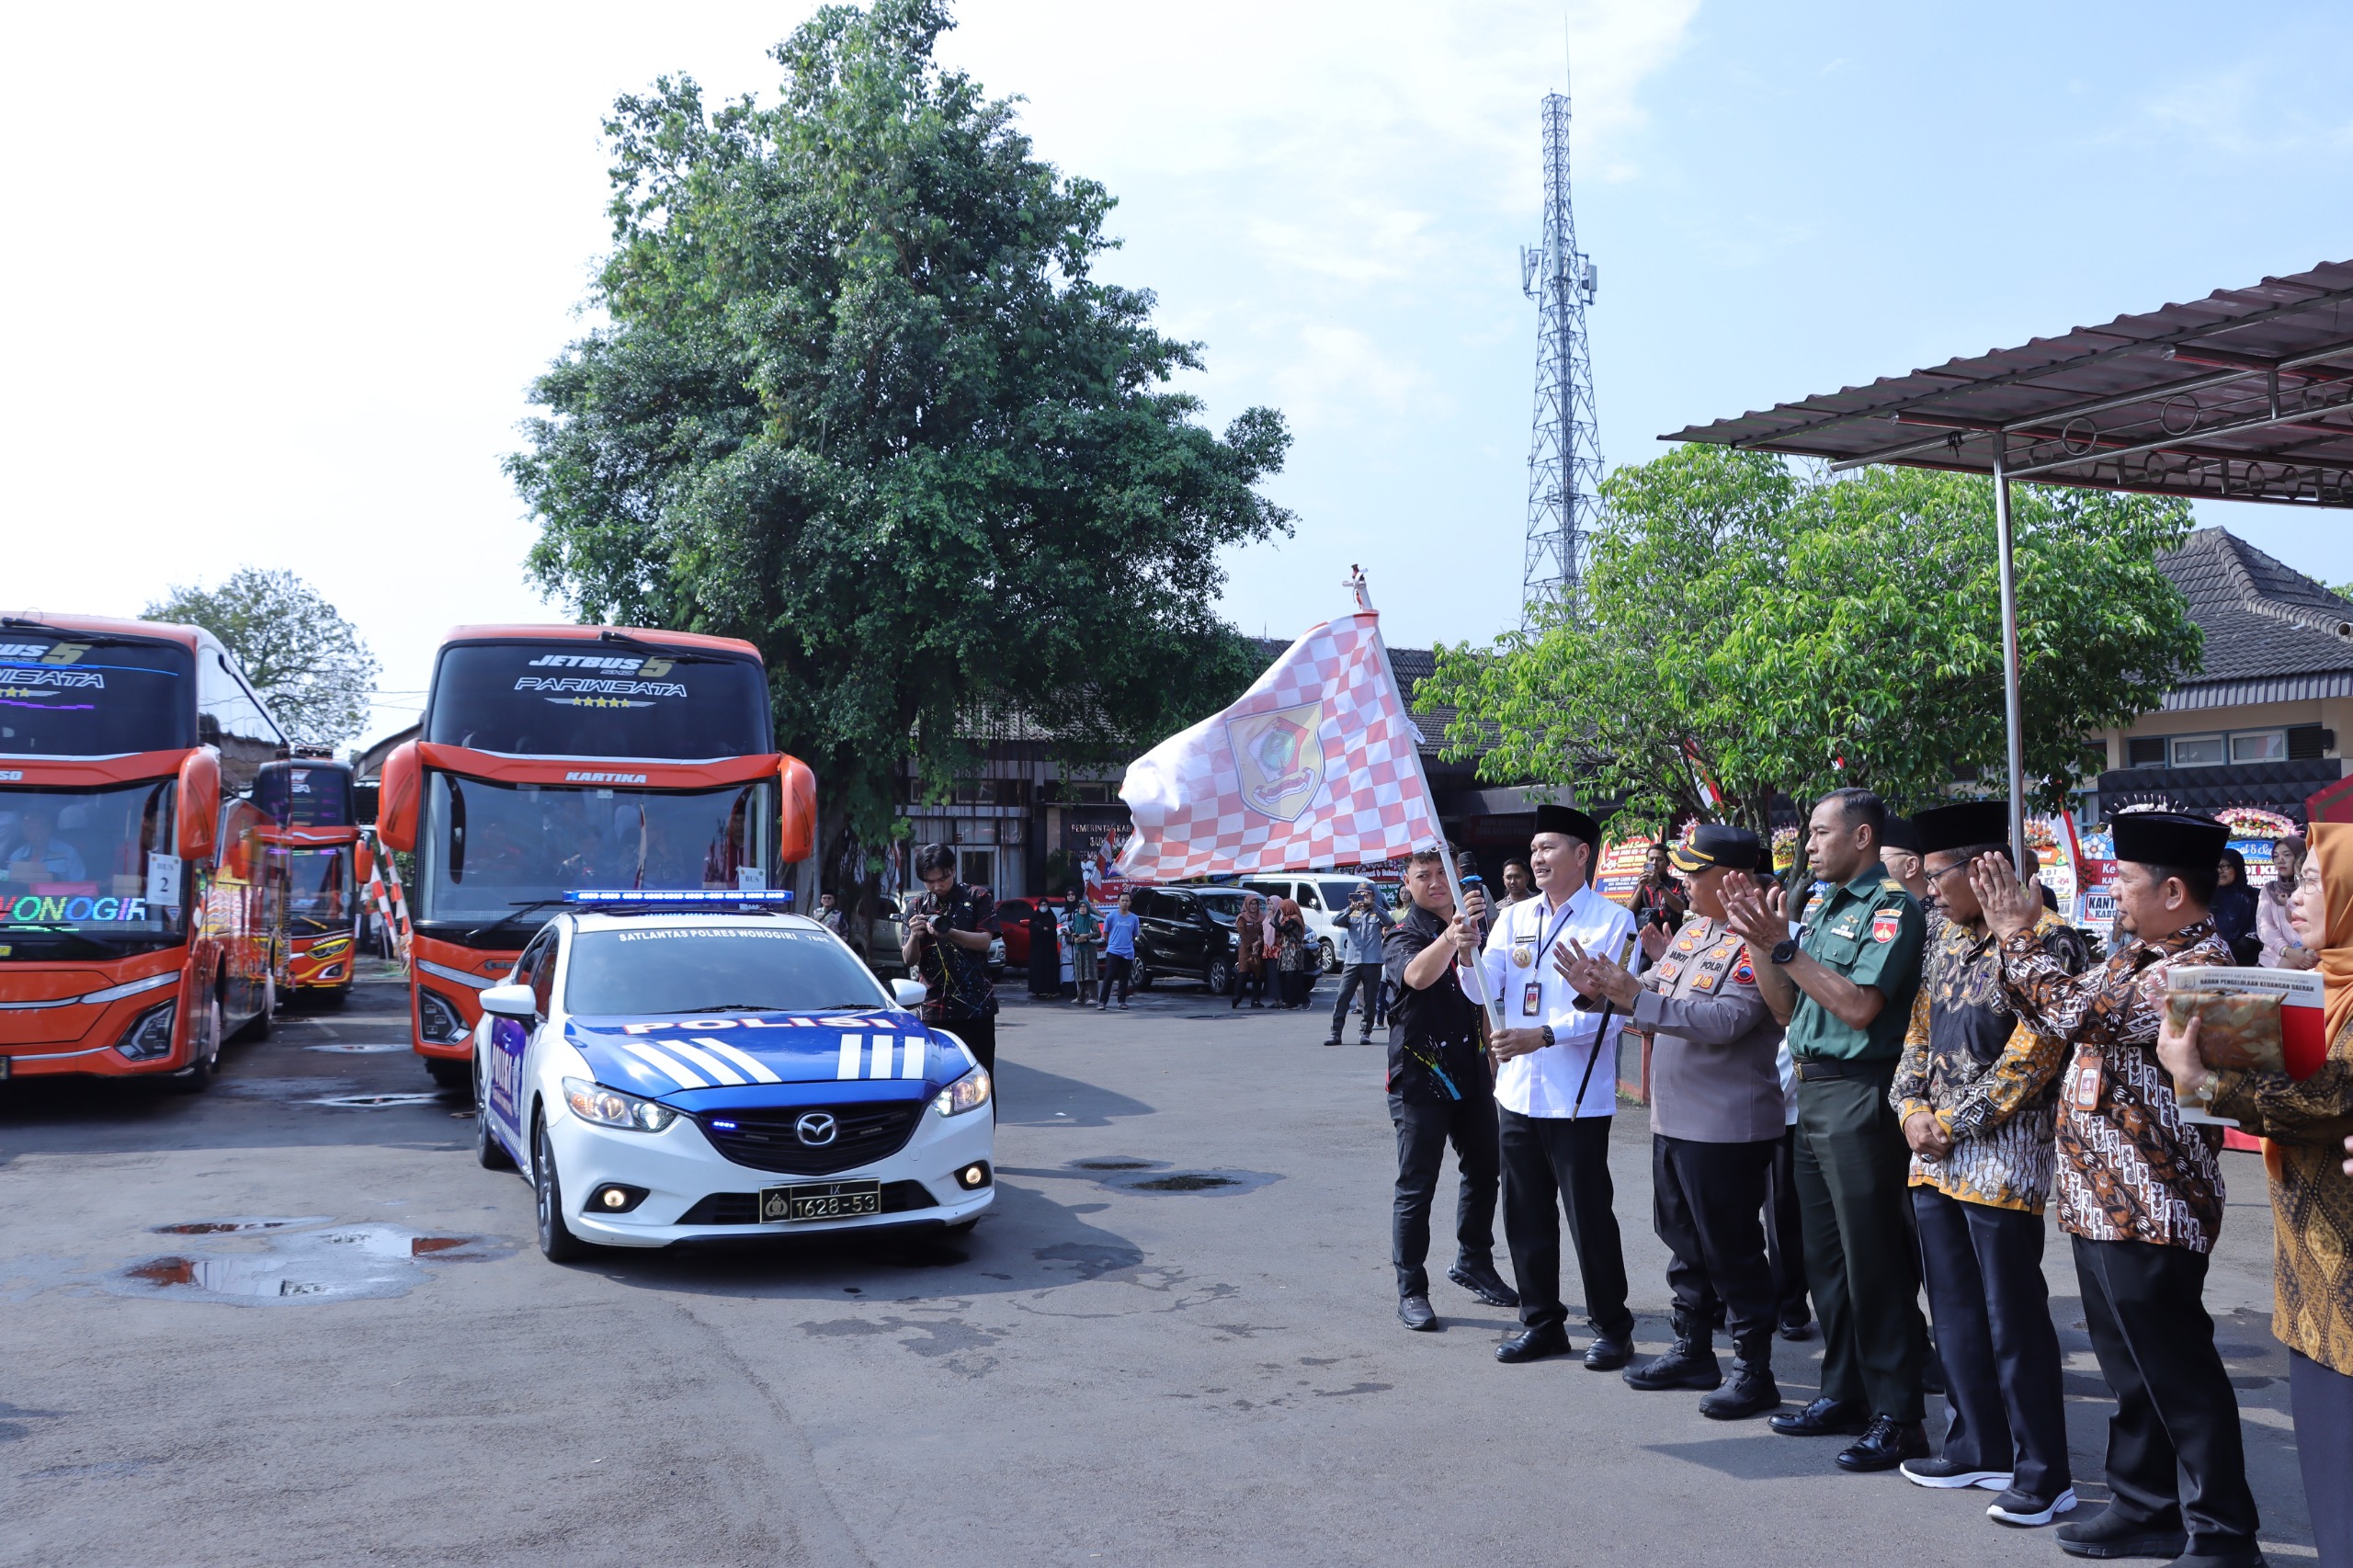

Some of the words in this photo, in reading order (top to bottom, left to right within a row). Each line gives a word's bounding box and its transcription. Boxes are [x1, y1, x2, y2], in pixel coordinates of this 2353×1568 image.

[41, 642, 93, 665] 5
[529, 655, 643, 670] JETBUS
[638, 655, 677, 677] 5
[514, 677, 688, 698] PARIWISATA
[565, 772, 647, 783] KARTIKA
[1071, 824, 1114, 833] PEMERINTA
[2250, 844, 2256, 854] &
[156, 862, 175, 871] BUS
[159, 877, 168, 892] 2
[745, 875, 760, 883] BUS
[620, 929, 688, 942] SATLANTAS
[689, 929, 736, 938] POLRES
[737, 929, 798, 940] WONOGIRI
[1700, 960, 1724, 972] POLRI
[2259, 982, 2290, 990] KEUANGAN
[2291, 984, 2314, 993] DAERAH
[622, 1017, 899, 1036] POLISI
[830, 1185, 841, 1195] IX
[796, 1195, 875, 1217] 1628-53
